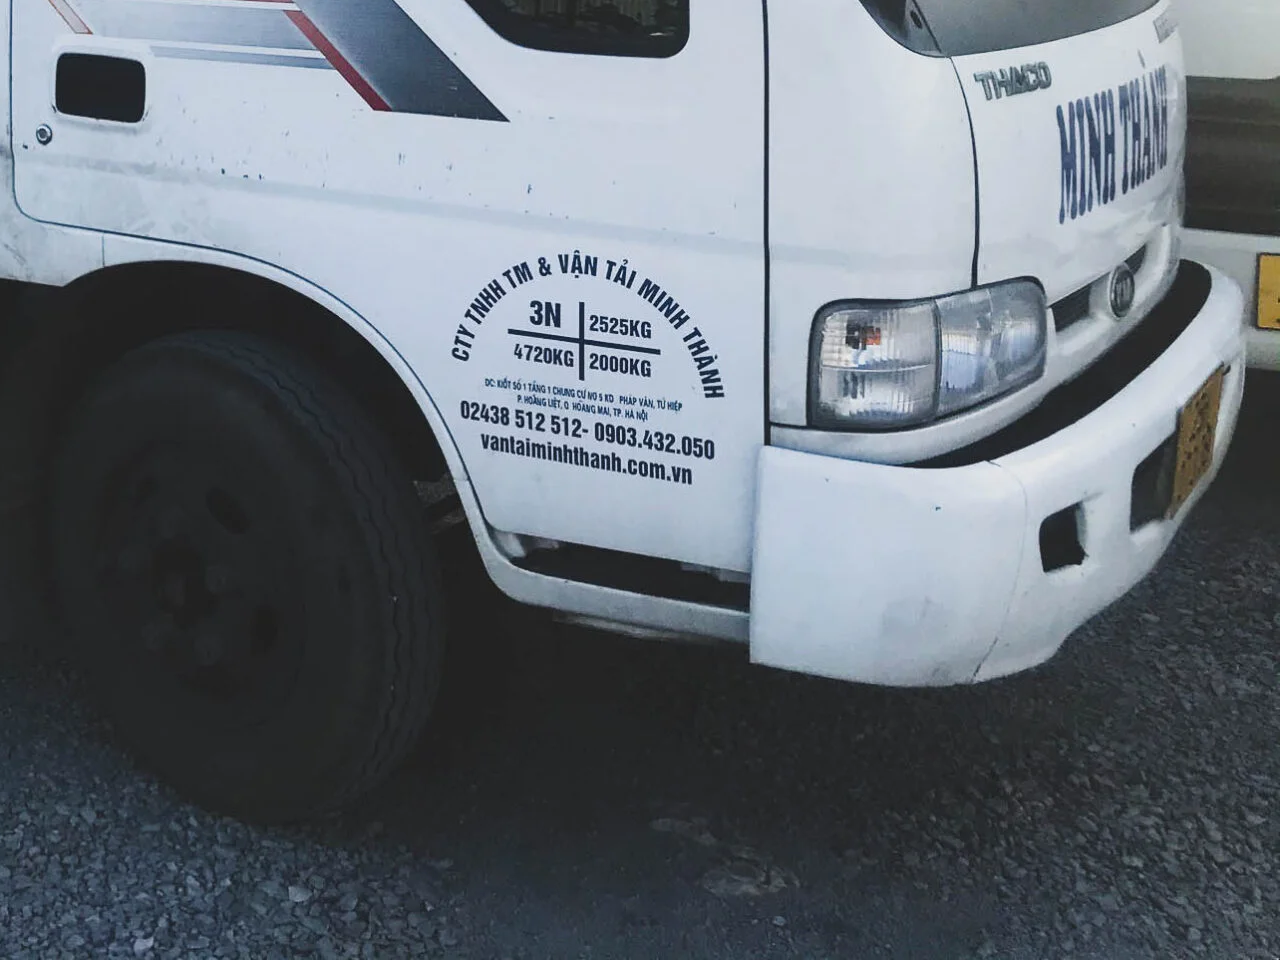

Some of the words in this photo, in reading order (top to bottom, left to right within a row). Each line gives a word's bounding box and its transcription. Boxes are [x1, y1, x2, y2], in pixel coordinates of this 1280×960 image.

[974, 61, 1052, 101] THACO
[1056, 88, 1116, 225] MINH
[451, 323, 475, 362] CTY
[464, 279, 507, 325] TNHH
[502, 261, 534, 289] TM
[537, 256, 552, 277] &
[558, 249, 598, 279] VẬN
[605, 259, 637, 290] TẢI
[637, 278, 690, 330] MINH
[683, 327, 725, 399] THÀNH
[529, 300, 561, 328] 3N
[589, 314, 652, 339] 2525KG
[513, 343, 574, 368] 4720KG
[589, 353, 652, 378] 2000KG
[460, 401, 510, 426] 02438
[515, 409, 546, 433] 512
[595, 422, 715, 460] 0903.432.050
[481, 433, 693, 486] vantaiminhthanh.com.vn
